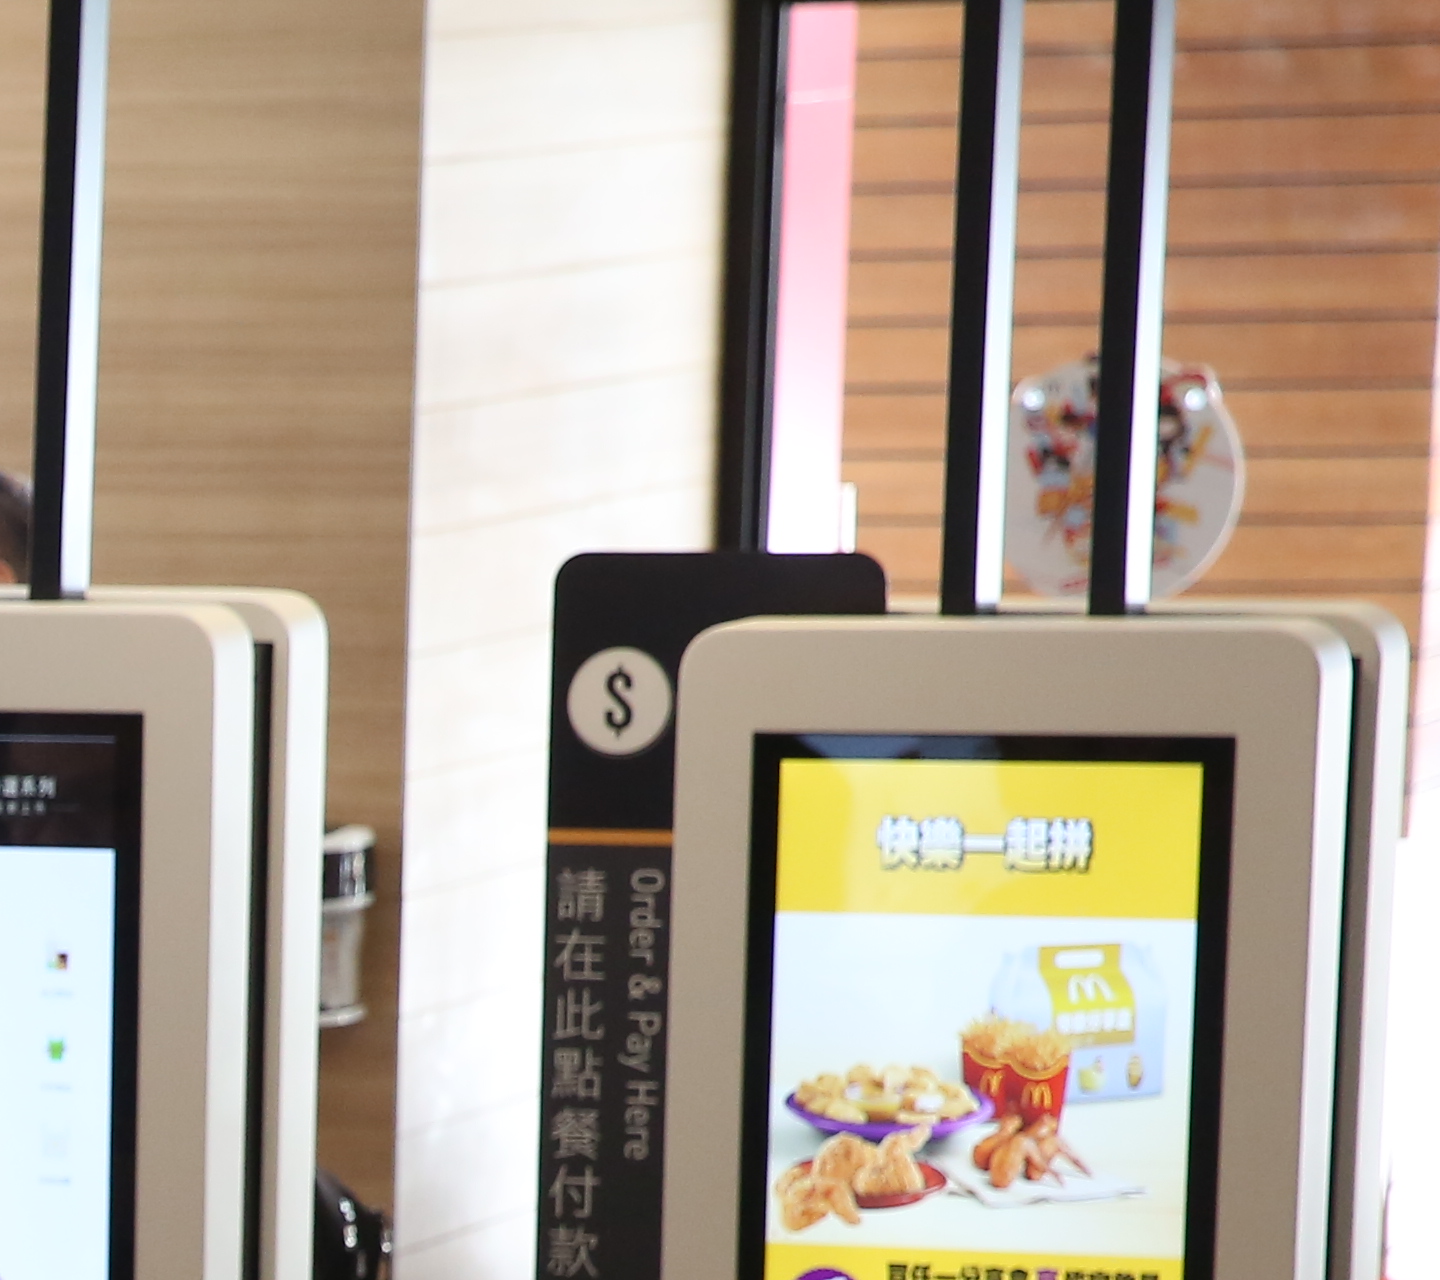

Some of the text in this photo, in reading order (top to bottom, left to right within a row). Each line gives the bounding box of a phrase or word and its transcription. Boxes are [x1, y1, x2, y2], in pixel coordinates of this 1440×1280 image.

[627, 867, 666, 966] Order
[547, 867, 608, 1278] 請在此點餐付款
[617, 1010, 662, 1072] Pay
[622, 1079, 660, 1161] Here
